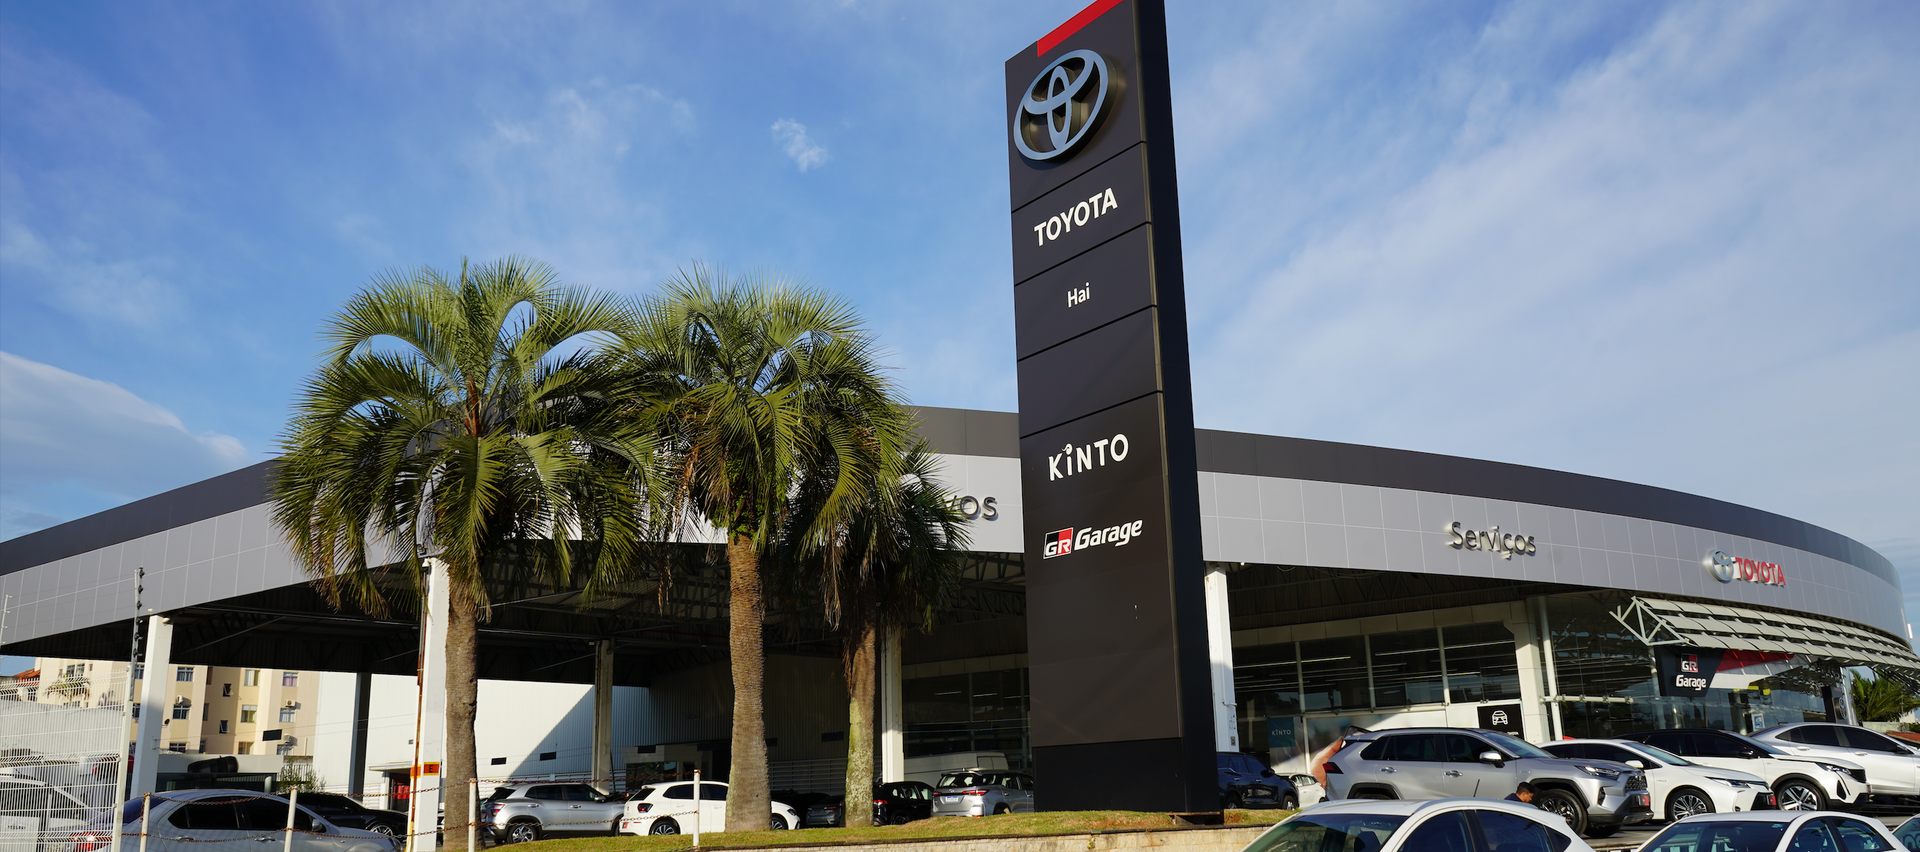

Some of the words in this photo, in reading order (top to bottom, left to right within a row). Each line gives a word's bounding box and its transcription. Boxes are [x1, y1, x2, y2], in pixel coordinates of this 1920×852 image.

[1033, 187, 1118, 247] TOYOTA
[1067, 281, 1090, 308] Hai
[1045, 538, 1071, 557] GR
[1074, 519, 1143, 551] Garage
[1450, 521, 1537, 560] Serviços
[1735, 556, 1787, 586] TOYOTA
[1675, 674, 1707, 691] Garage
